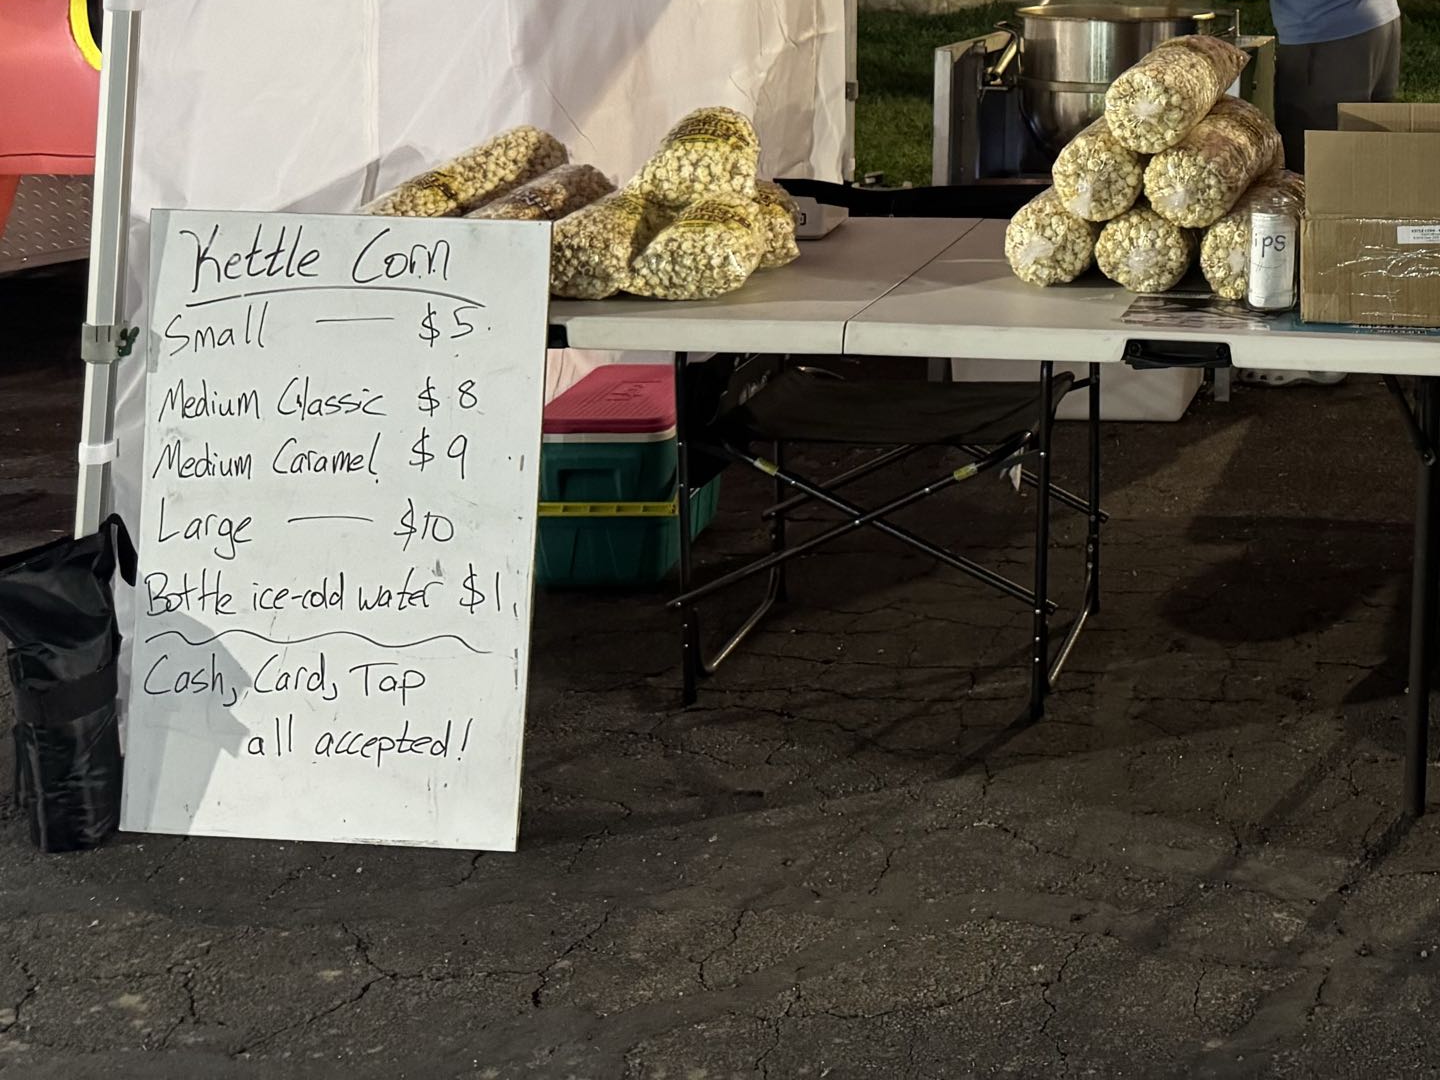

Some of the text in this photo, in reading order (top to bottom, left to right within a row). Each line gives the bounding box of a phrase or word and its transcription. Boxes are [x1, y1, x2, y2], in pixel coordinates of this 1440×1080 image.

[180, 225, 451, 292] Kettle Corn
[165, 302, 268, 356] Small
[159, 379, 260, 422] Medium
[277, 376, 388, 421] Classic
[152, 440, 252, 480] Medium
[272, 432, 381, 478] Caramel
[158, 497, 455, 560] Large $10
[144, 568, 236, 617] Bottle
[358, 567, 444, 612] water
[144, 652, 425, 707] Cash, Card, Tap
[247, 714, 473, 768] all accepted!
